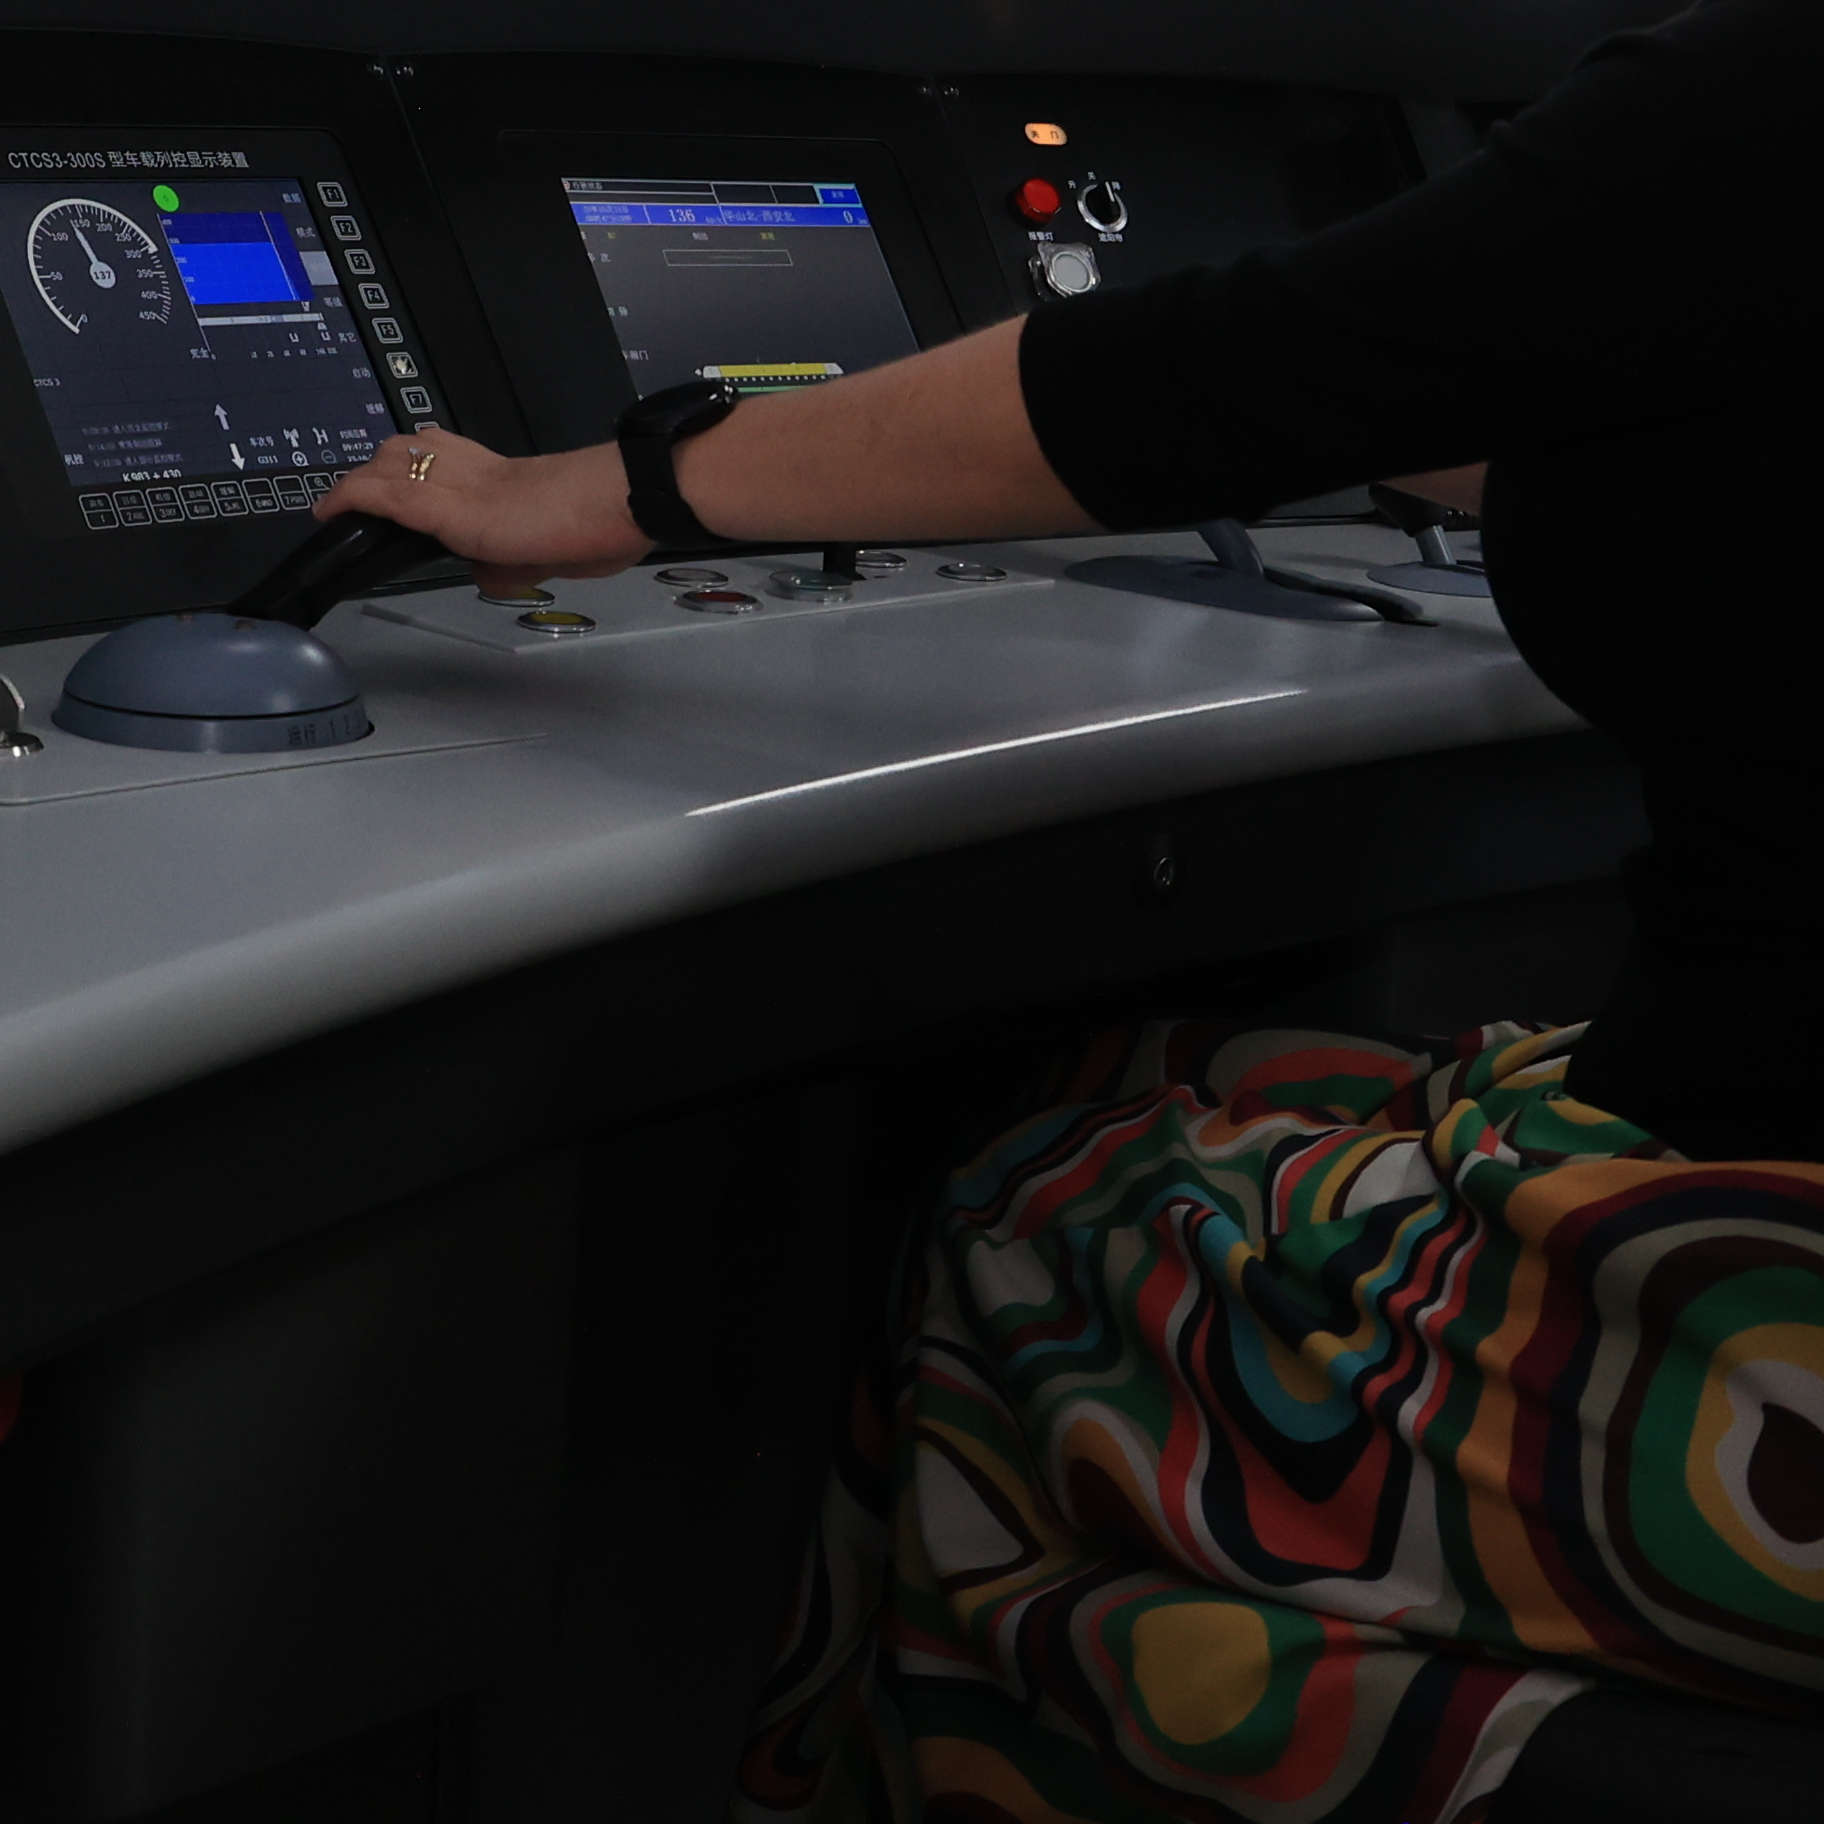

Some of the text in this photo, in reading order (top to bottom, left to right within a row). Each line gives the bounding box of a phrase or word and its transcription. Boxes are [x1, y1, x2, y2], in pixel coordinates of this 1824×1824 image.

[7, 150, 250, 170] CTCS3-300S 型车载列控显示装置
[326, 189, 340, 200] F1
[668, 208, 696, 223] 136
[74, 218, 91, 228] 150
[95, 222, 113, 232] 200
[340, 222, 354, 234] F2
[50, 232, 69, 242] 100
[353, 255, 367, 267] F3
[92, 270, 111, 281] 137
[366, 290, 381, 302] F4
[380, 324, 395, 336] F5
[408, 393, 423, 405] F7
